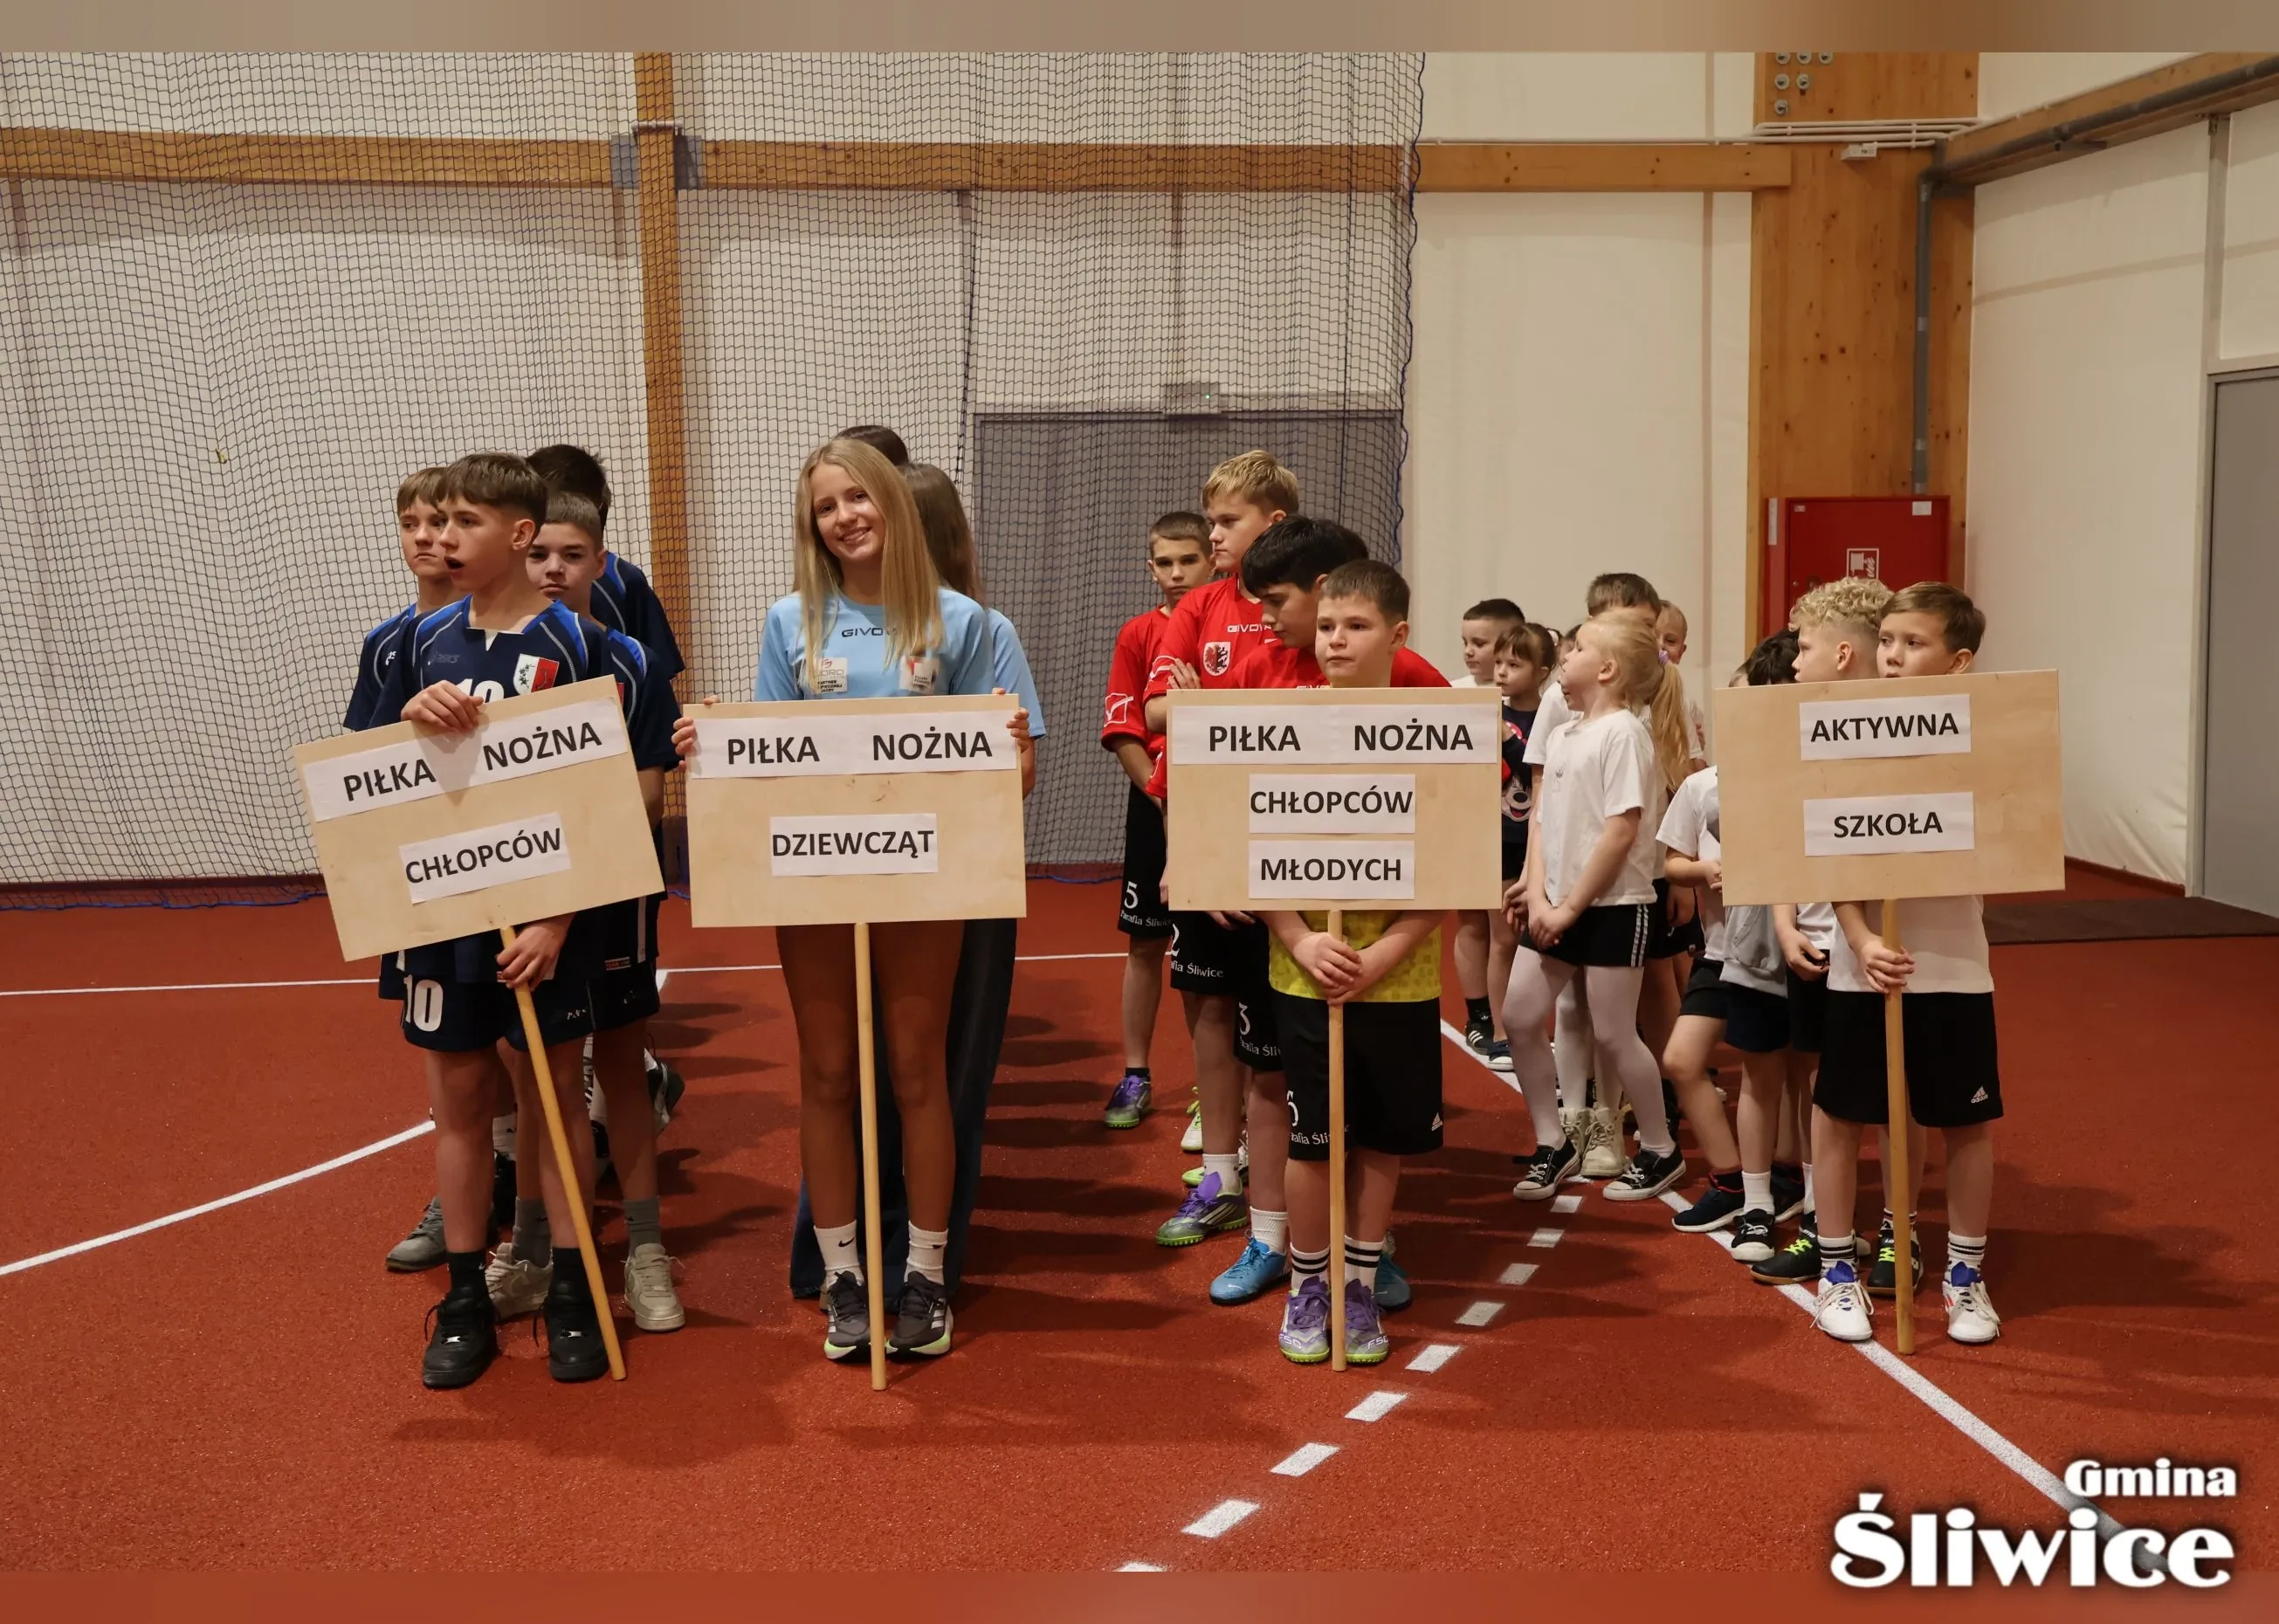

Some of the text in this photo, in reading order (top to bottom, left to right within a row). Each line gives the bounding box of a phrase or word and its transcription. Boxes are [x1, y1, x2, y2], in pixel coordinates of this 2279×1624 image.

[842, 627, 896, 637] GIVO
[1209, 718, 1474, 752] PIŁKA NOŻNA
[1810, 712, 1959, 743] AKTYWNA
[727, 726, 993, 765] PIŁKA NOŻNA
[344, 721, 602, 802] PIŁKA NOŻNA
[1250, 785, 1414, 814] CHŁOPCÓW
[1834, 811, 1944, 838] SZKOŁA
[405, 827, 561, 884] CHŁOPCÓW
[772, 830, 934, 859] DZIEWCZĄT
[1261, 858, 1401, 881] MŁODYCH
[1124, 880, 1139, 909] 5
[1187, 962, 1223, 978] Śliwice
[403, 974, 444, 1032] 10
[1238, 1001, 1251, 1036] 3
